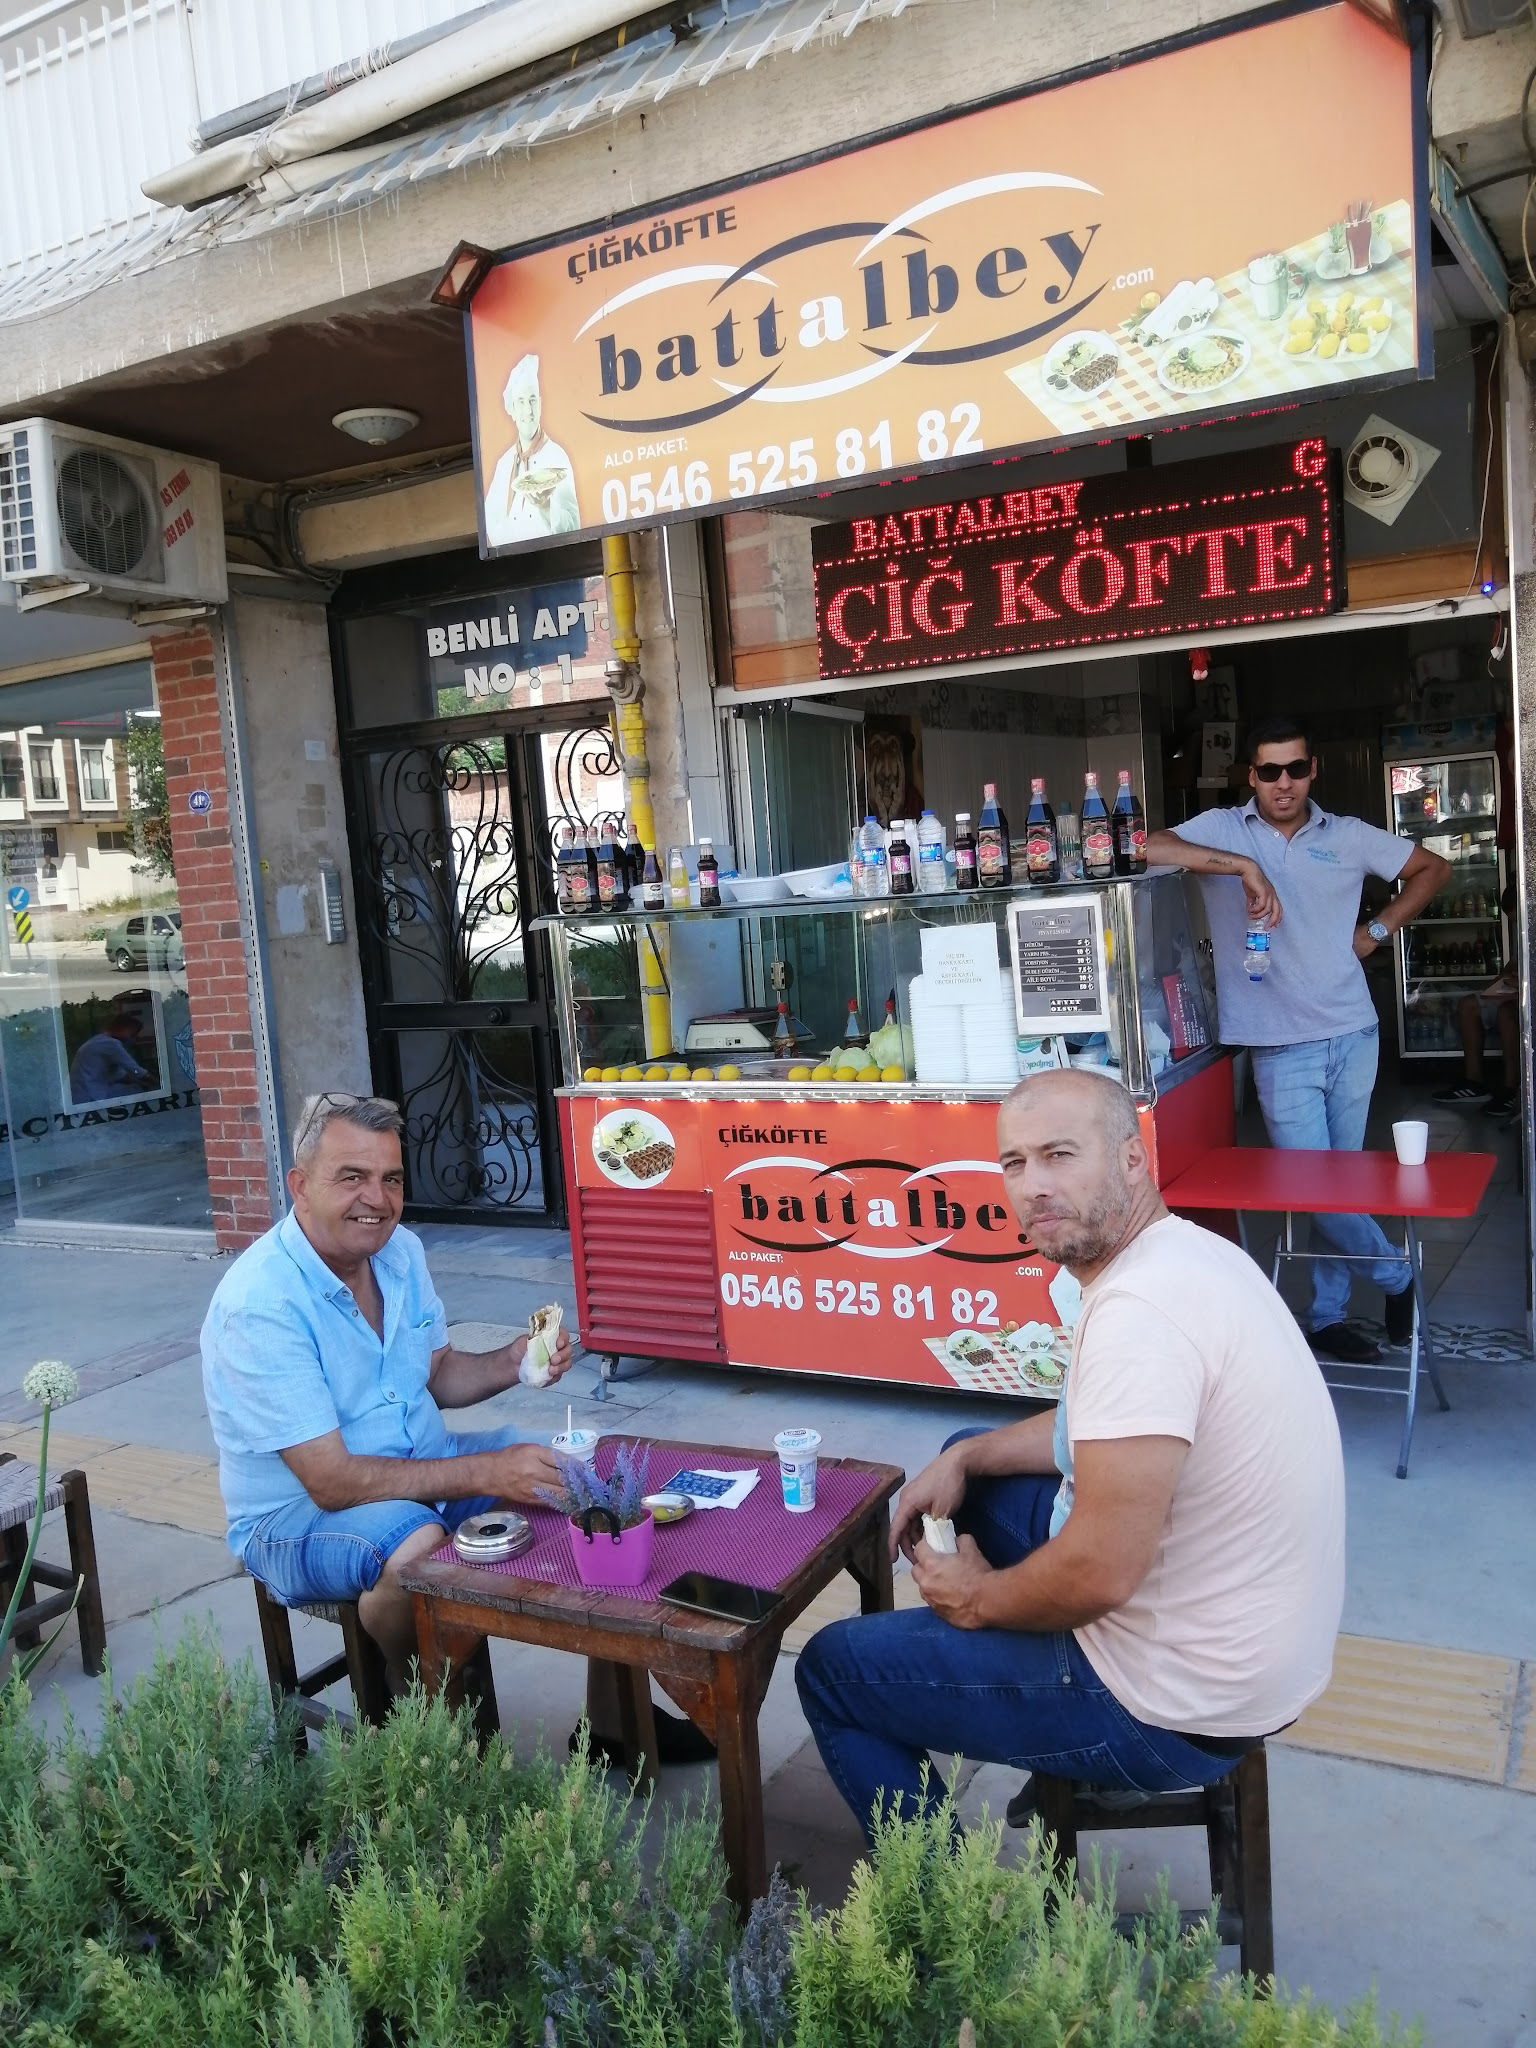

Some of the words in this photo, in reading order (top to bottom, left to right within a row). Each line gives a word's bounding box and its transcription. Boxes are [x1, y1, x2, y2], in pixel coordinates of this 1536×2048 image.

[567, 205, 738, 284] ÇİĞKÖFTE
[1112, 265, 1155, 291] .com
[594, 223, 1102, 397] battalbey
[602, 459, 712, 524] 0546
[728, 438, 818, 500] 525
[836, 419, 893, 479] 81
[917, 402, 984, 462] 82
[604, 449, 634, 469] ALO
[637, 437, 688, 462] PAKET:
[1293, 438, 1327, 479] G
[825, 555, 973, 663] ÇİĞ
[991, 516, 1312, 628] KÖFTE
[426, 605, 519, 658] BENLİ
[532, 600, 610, 641] APT.
[464, 663, 516, 699] NO
[557, 654, 573, 685] 1
[718, 1124, 828, 1148] ÇİĞKÖFTE
[738, 1184, 1033, 1244] battalbe
[728, 1250, 749, 1262] ALO
[750, 1252, 784, 1263] PAKET:
[1015, 1265, 1043, 1277] .com
[720, 1272, 804, 1311] 0546
[815, 1278, 880, 1317] 525
[892, 1283, 935, 1321] 81
[951, 1287, 1000, 1327] 82
